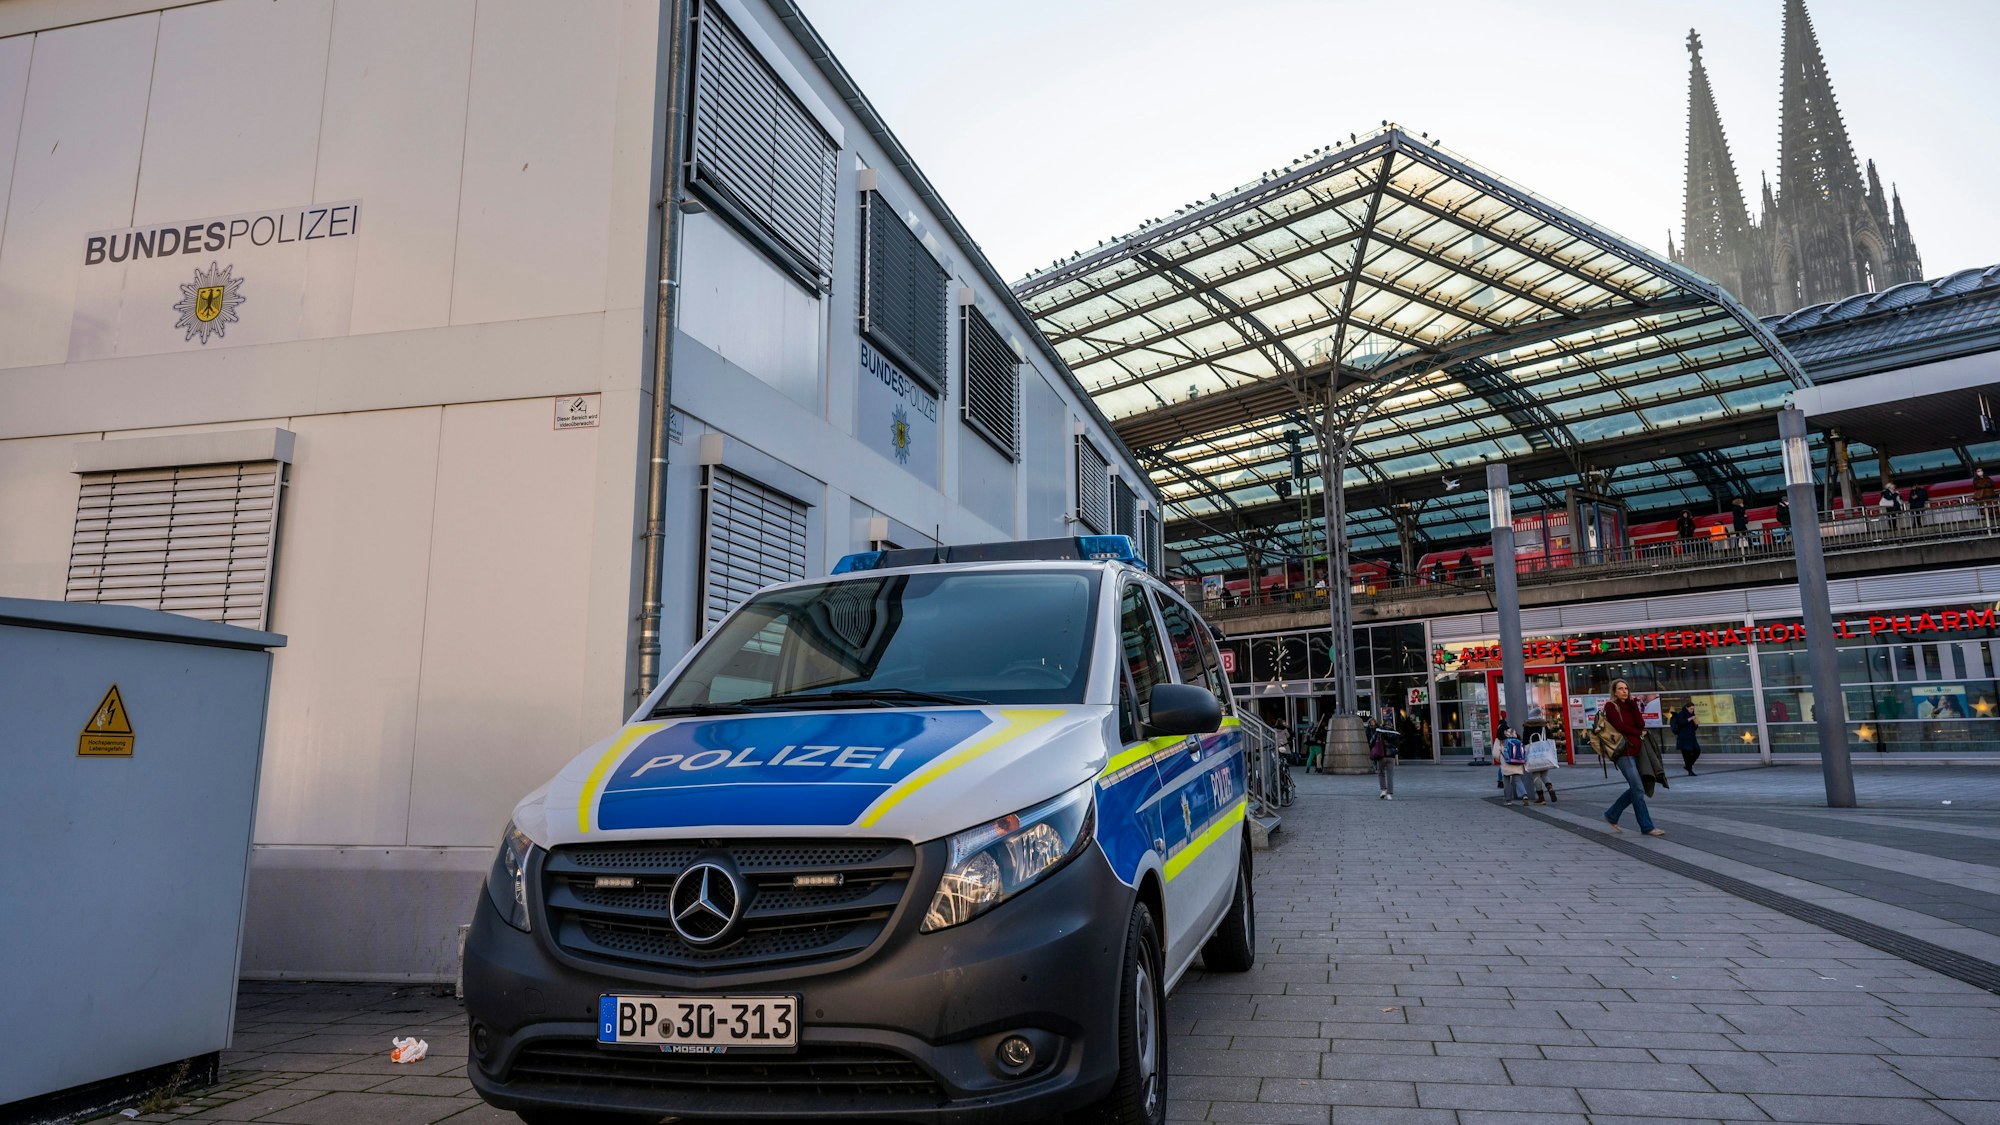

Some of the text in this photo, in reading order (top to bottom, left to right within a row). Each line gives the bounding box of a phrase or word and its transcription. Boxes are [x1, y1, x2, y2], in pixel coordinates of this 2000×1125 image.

[85, 205, 358, 266] BUNDESPOLIZEI
[861, 343, 937, 424] BUNDESPOLIZEI
[1459, 608, 1996, 663] APOHEKE INTERNATIONL PHARM
[630, 745, 905, 777] POLIZEI
[619, 1002, 658, 1037] BP
[676, 1003, 792, 1039] 30-313
[673, 1045, 715, 1054] MOSOLF
